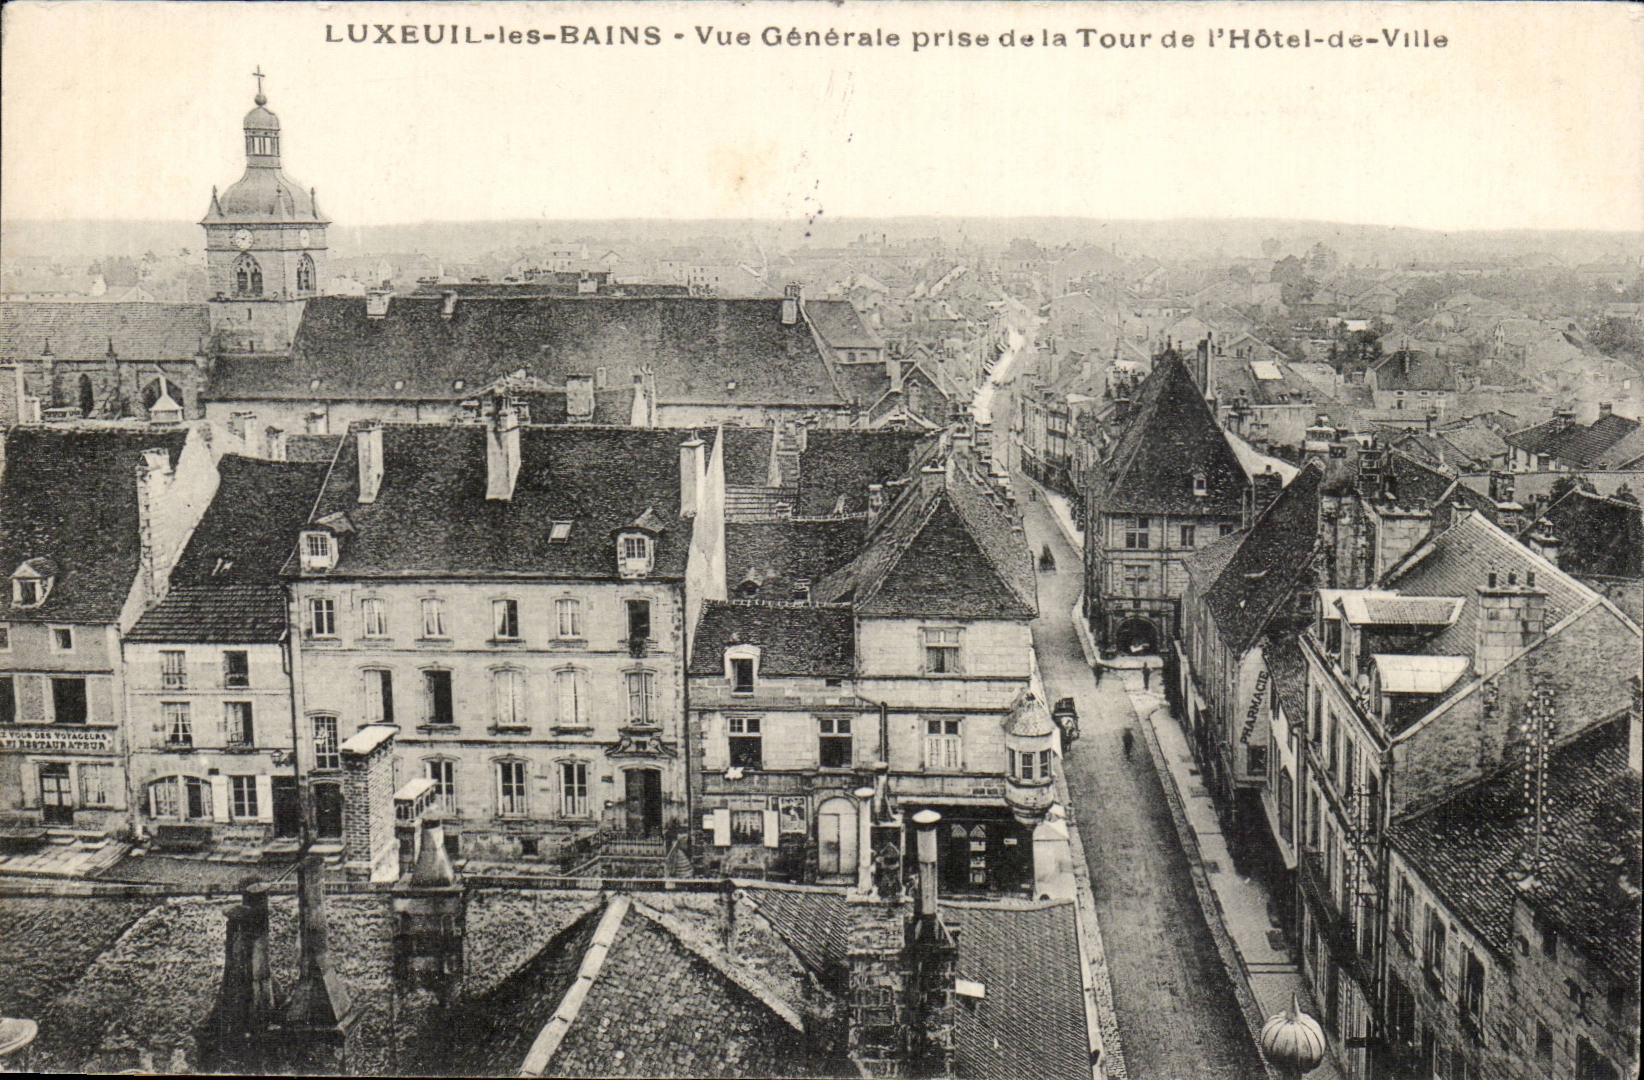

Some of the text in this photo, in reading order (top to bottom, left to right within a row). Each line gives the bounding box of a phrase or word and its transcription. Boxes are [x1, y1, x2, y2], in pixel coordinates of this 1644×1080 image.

[1240, 670, 1270, 745] PHARMACIE
[54, 732, 107, 741] VOYAGEURS
[19, 740, 106, 750] RESTAURATEUR
